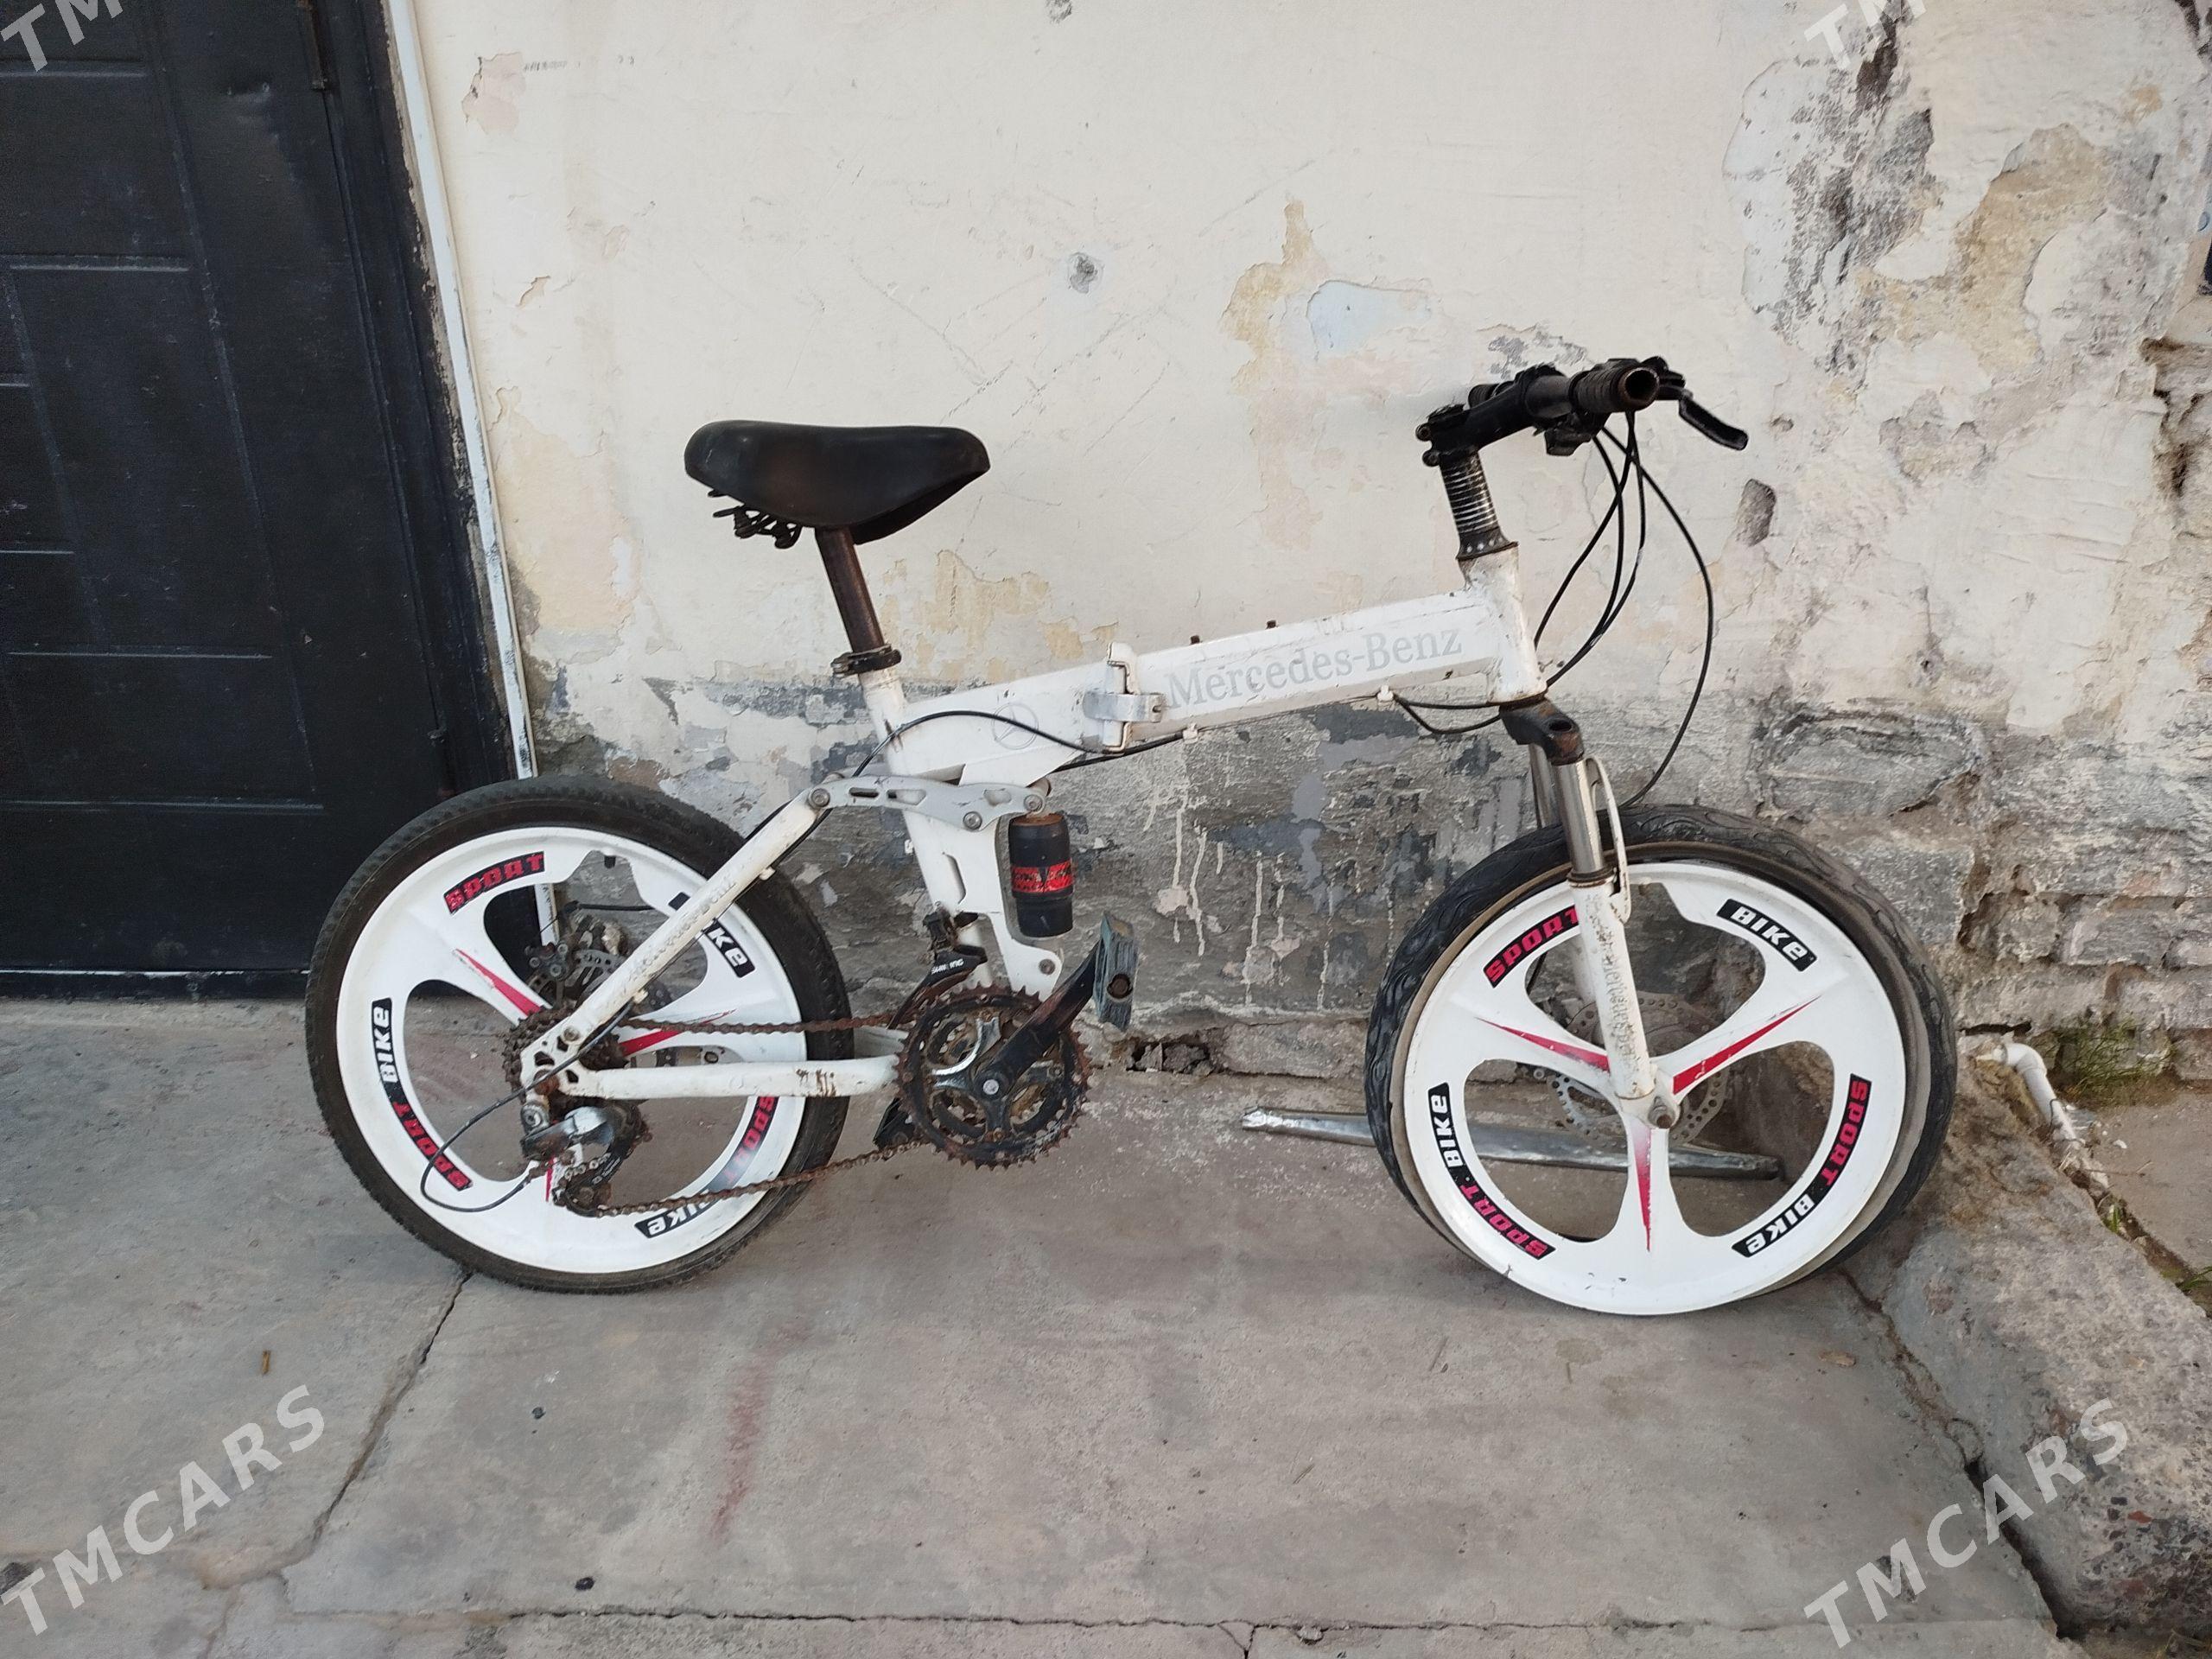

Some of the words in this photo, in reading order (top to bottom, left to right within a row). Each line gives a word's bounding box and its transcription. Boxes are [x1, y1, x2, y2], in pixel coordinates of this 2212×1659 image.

[1166, 629, 1462, 709] Mercedes-Benz
[1821, 1080, 1868, 1186] SPORT
[1460, 1185, 1548, 1257] SPORT
